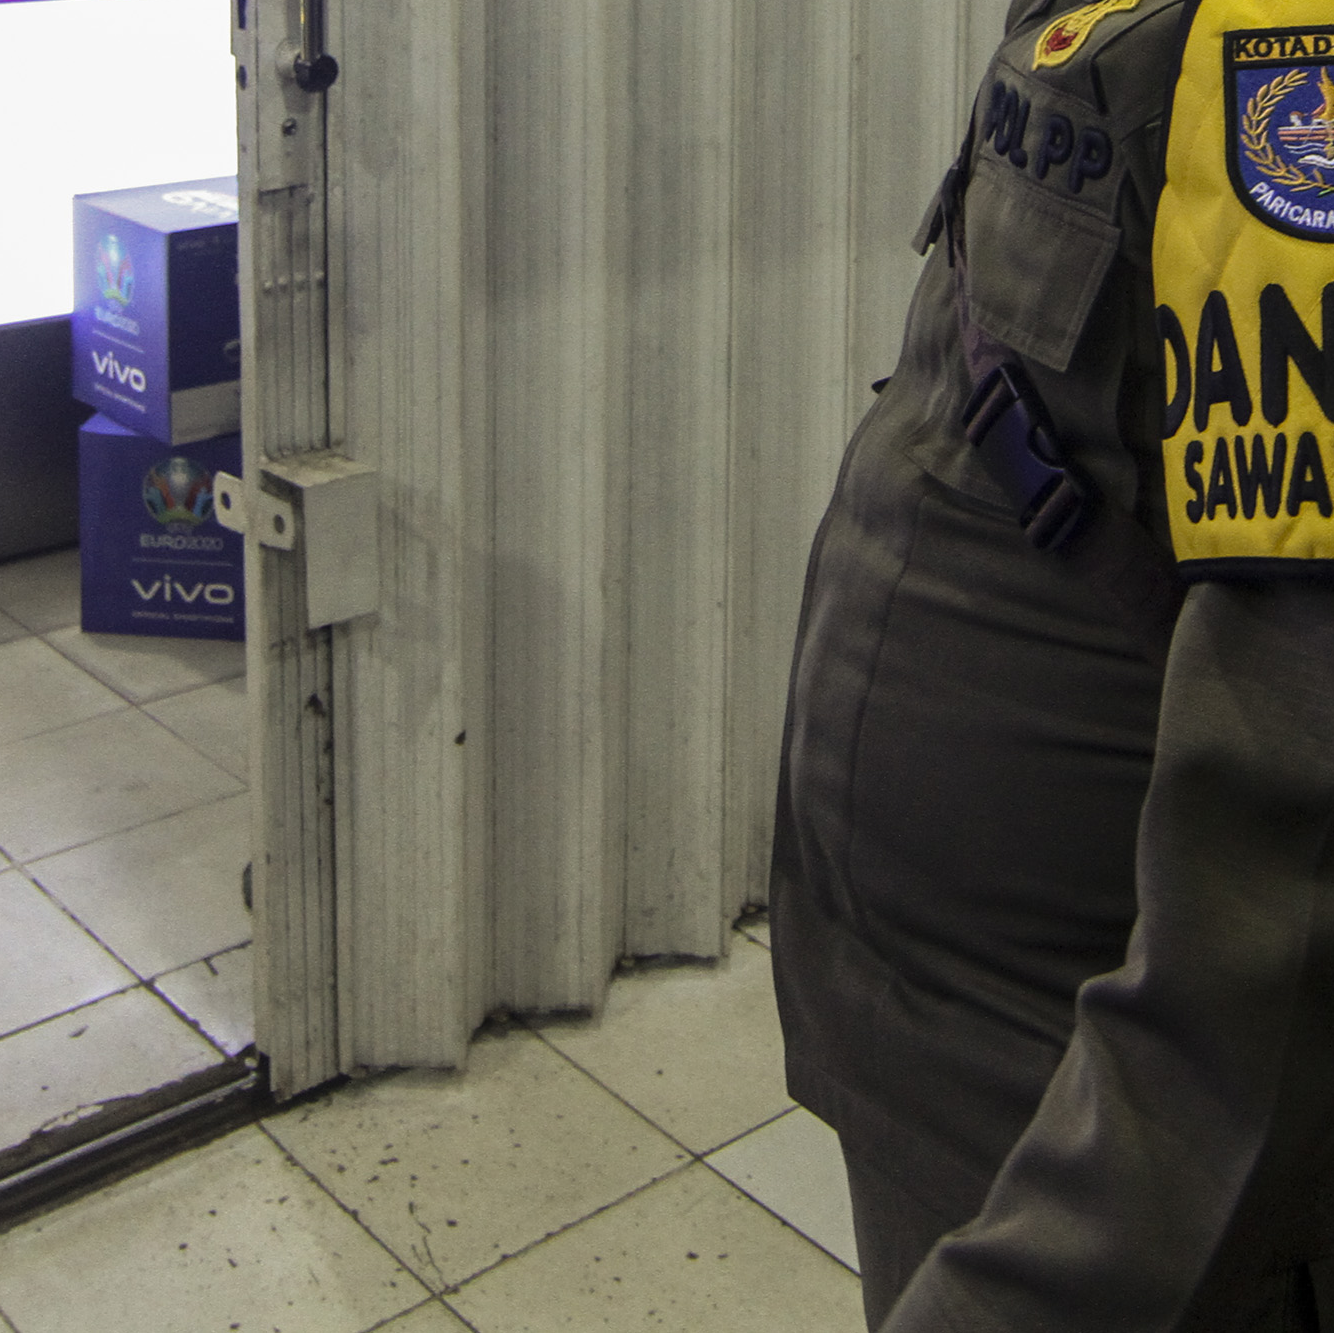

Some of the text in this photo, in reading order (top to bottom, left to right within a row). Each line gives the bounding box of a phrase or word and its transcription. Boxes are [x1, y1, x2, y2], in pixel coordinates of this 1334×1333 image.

[1235, 35, 1308, 59] KOTA
[92, 351, 147, 393] vivo
[130, 574, 235, 605] vivo
